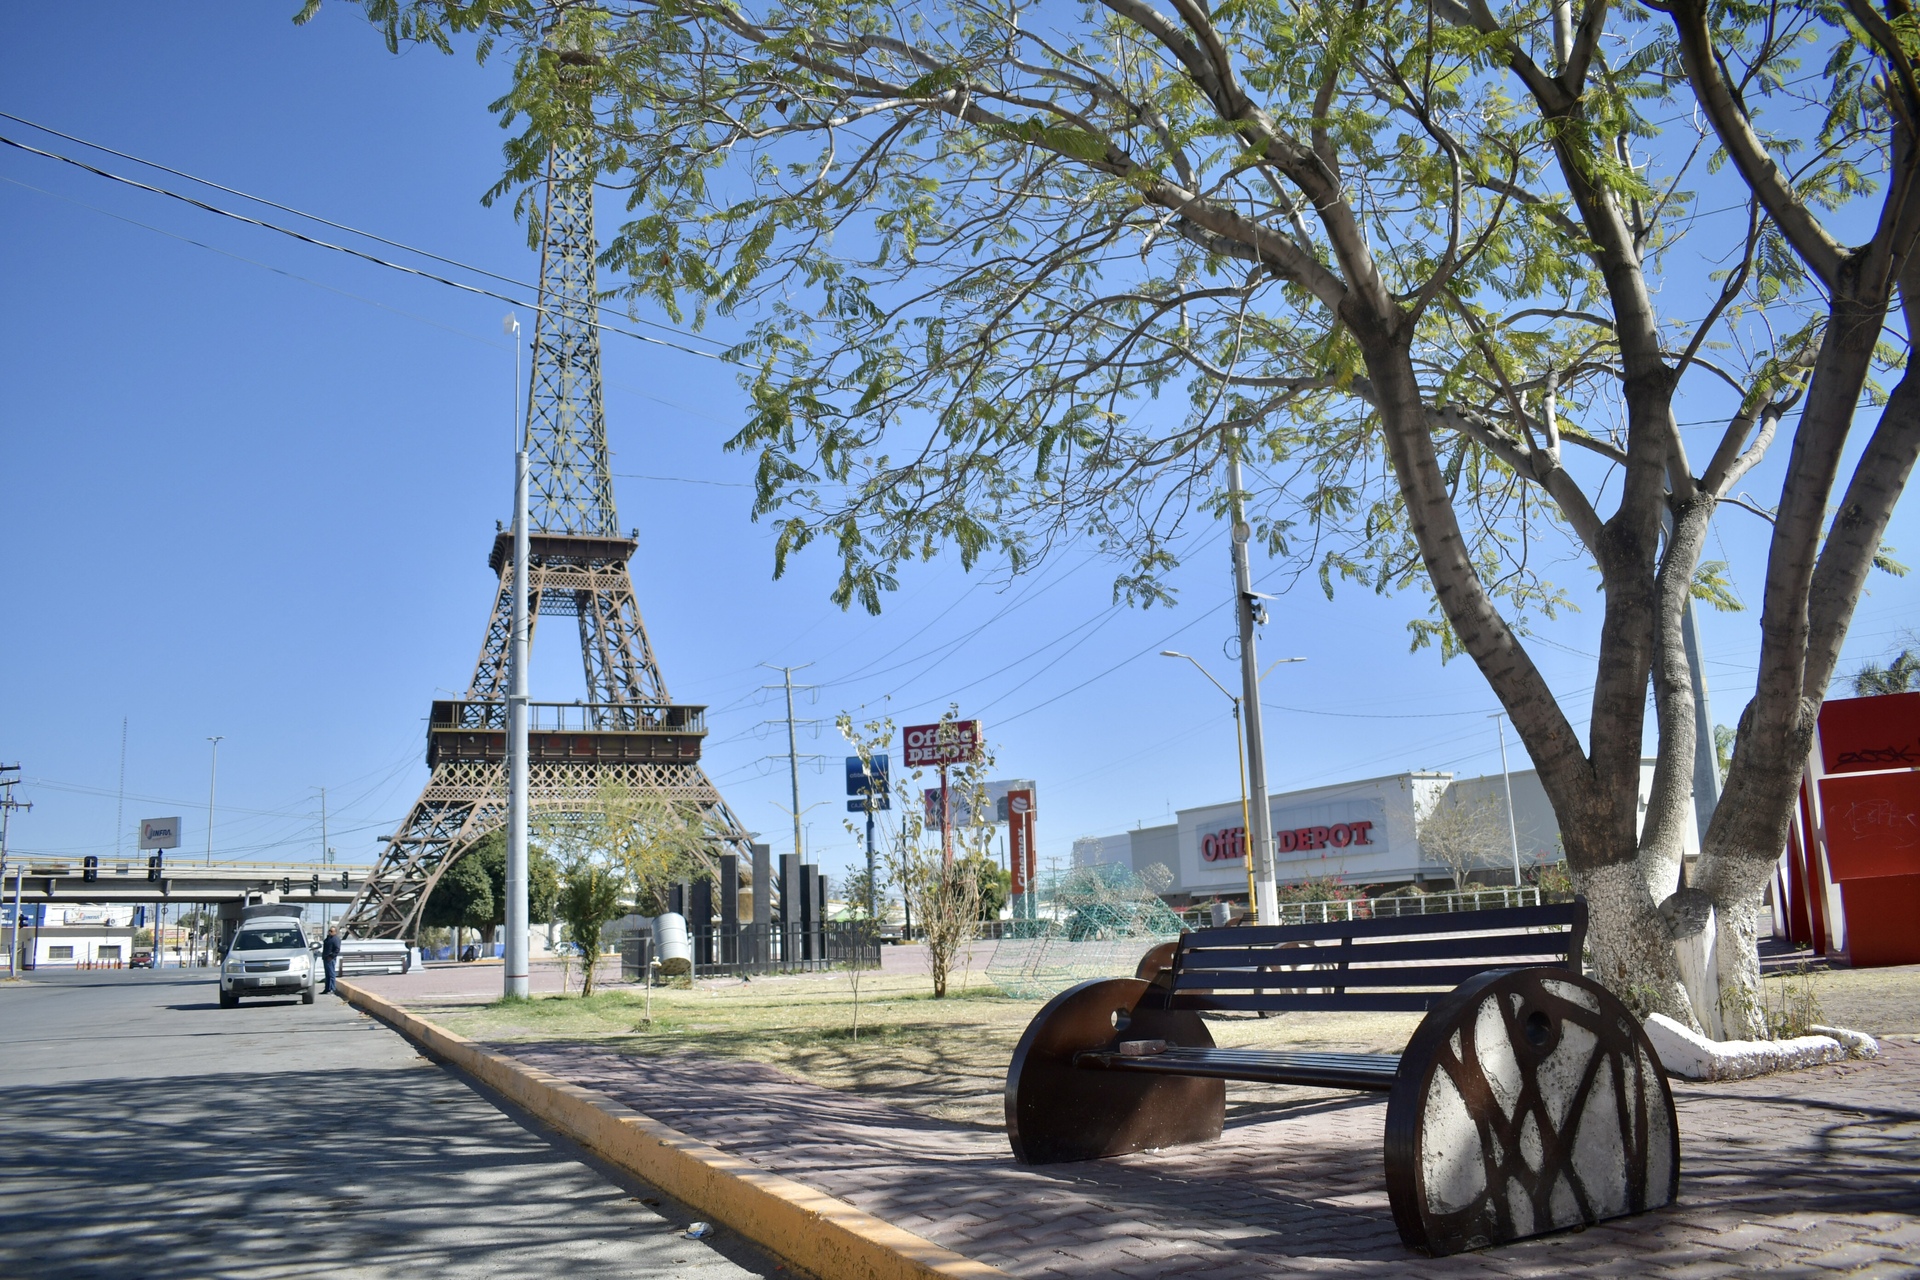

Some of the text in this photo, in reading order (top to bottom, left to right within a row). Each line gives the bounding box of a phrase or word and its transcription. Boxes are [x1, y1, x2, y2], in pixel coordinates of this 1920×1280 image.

[908, 743, 973, 762] DEPOT
[1017, 828, 1027, 887] Cinemex
[1201, 820, 1373, 862] Offi DEPOT
